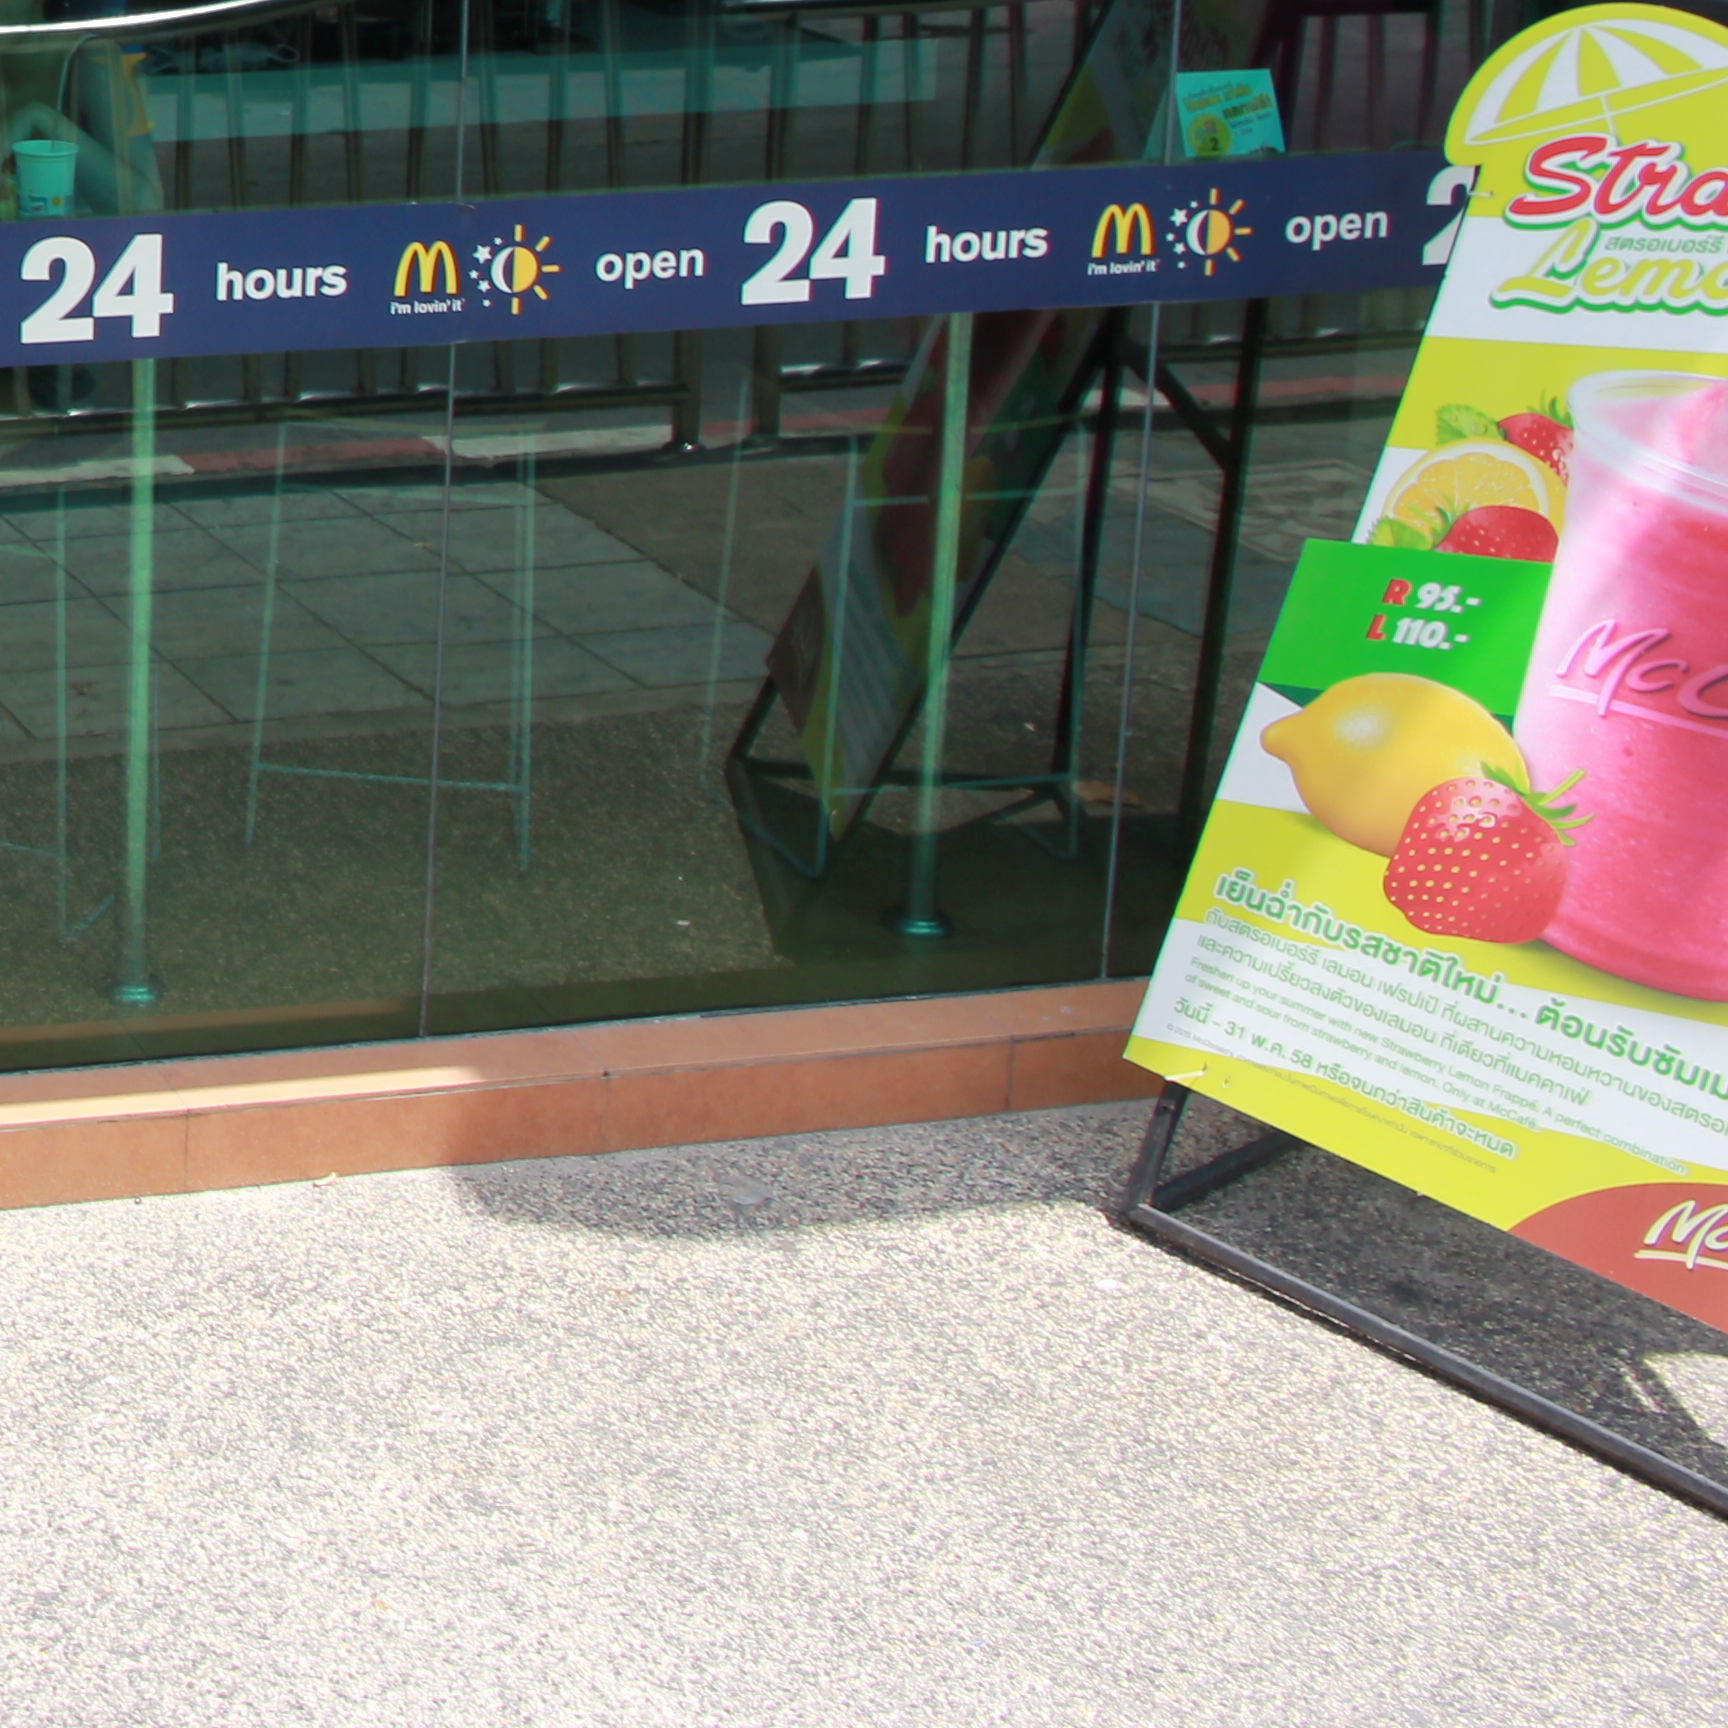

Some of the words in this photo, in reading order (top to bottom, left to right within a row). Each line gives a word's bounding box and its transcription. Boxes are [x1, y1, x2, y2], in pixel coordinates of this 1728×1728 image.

[597, 249, 704, 290] open
[741, 197, 886, 306] 24
[926, 225, 1048, 263] hours
[1287, 211, 1388, 251] open
[1422, 165, 1478, 266] 2
[21, 233, 174, 344] 24
[217, 262, 348, 301] hours
[1088, 263, 1108, 275] i'm
[1146, 260, 1156, 272] it
[390, 302, 412, 315] i'm
[450, 298, 462, 312] it
[1365, 613, 1388, 640] L
[1392, 616, 1470, 650] 110.-
[1381, 578, 1411, 606] R
[1415, 581, 1481, 614] 95.-
[1320, 956, 1374, 989] เลมอน
[1172, 993, 1212, 1024] วันนี้
[1223, 1021, 1246, 1040] 31
[1248, 1031, 1290, 1059] พ.ค.
[1289, 1049, 1313, 1069] 58
[1183, 972, 1197, 984] of
[1196, 978, 1231, 999] sweet
[1232, 992, 1255, 1009] and
[1255, 1003, 1281, 1020] sour
[1282, 1013, 1310, 1032] from
[1308, 1025, 1373, 1061] strawberry
[1373, 1052, 1398, 1069] and
[1440, 1082, 1471, 1103] Only
[1472, 1095, 1486, 1108] at
[1189, 957, 1234, 983] Freshen
[1234, 977, 1251, 992] up
[1251, 984, 1278, 1003] your
[1278, 996, 1325, 1021] summer
[1327, 1014, 1352, 1032] with
[1353, 1027, 1378, 1043] new
[1379, 1036, 1446, 1074] Strawberry
[1447, 1065, 1490, 1091] Lemon
[1541, 1106, 1554, 1118] A
[1553, 1111, 1601, 1140] perfect
[1601, 1132, 1686, 1175] combination
